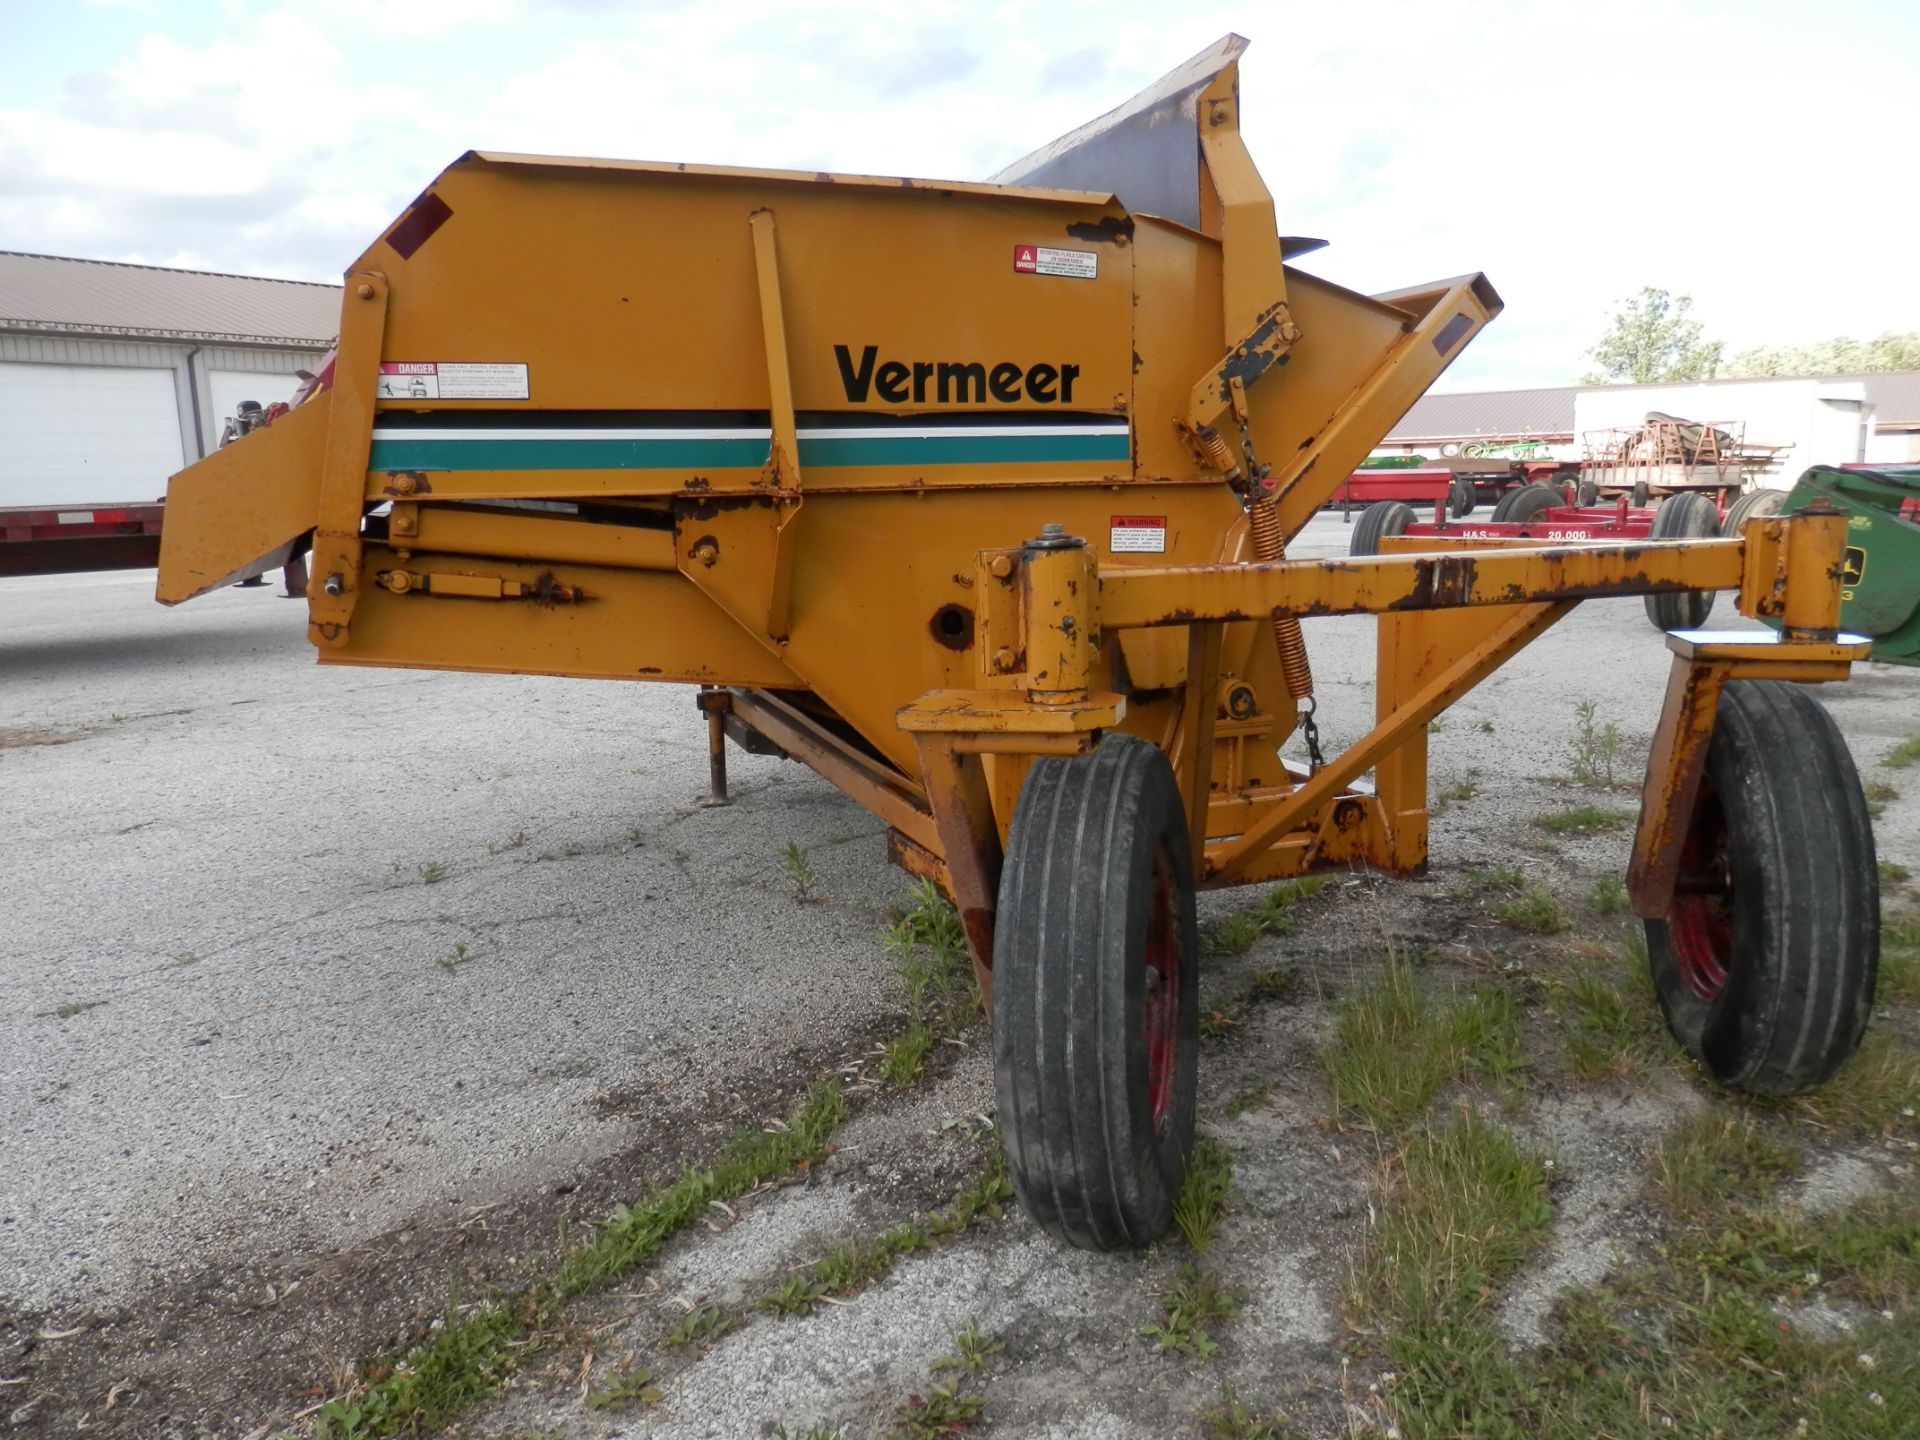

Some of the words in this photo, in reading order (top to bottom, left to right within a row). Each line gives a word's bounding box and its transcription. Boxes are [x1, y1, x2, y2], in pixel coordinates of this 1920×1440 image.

[1016, 261, 1035, 269] DANGER
[399, 363, 434, 374] DANGER
[834, 345, 1079, 403] Vermeer
[1127, 519, 1161, 527] WARNING
[1463, 531, 1486, 539] H&S
